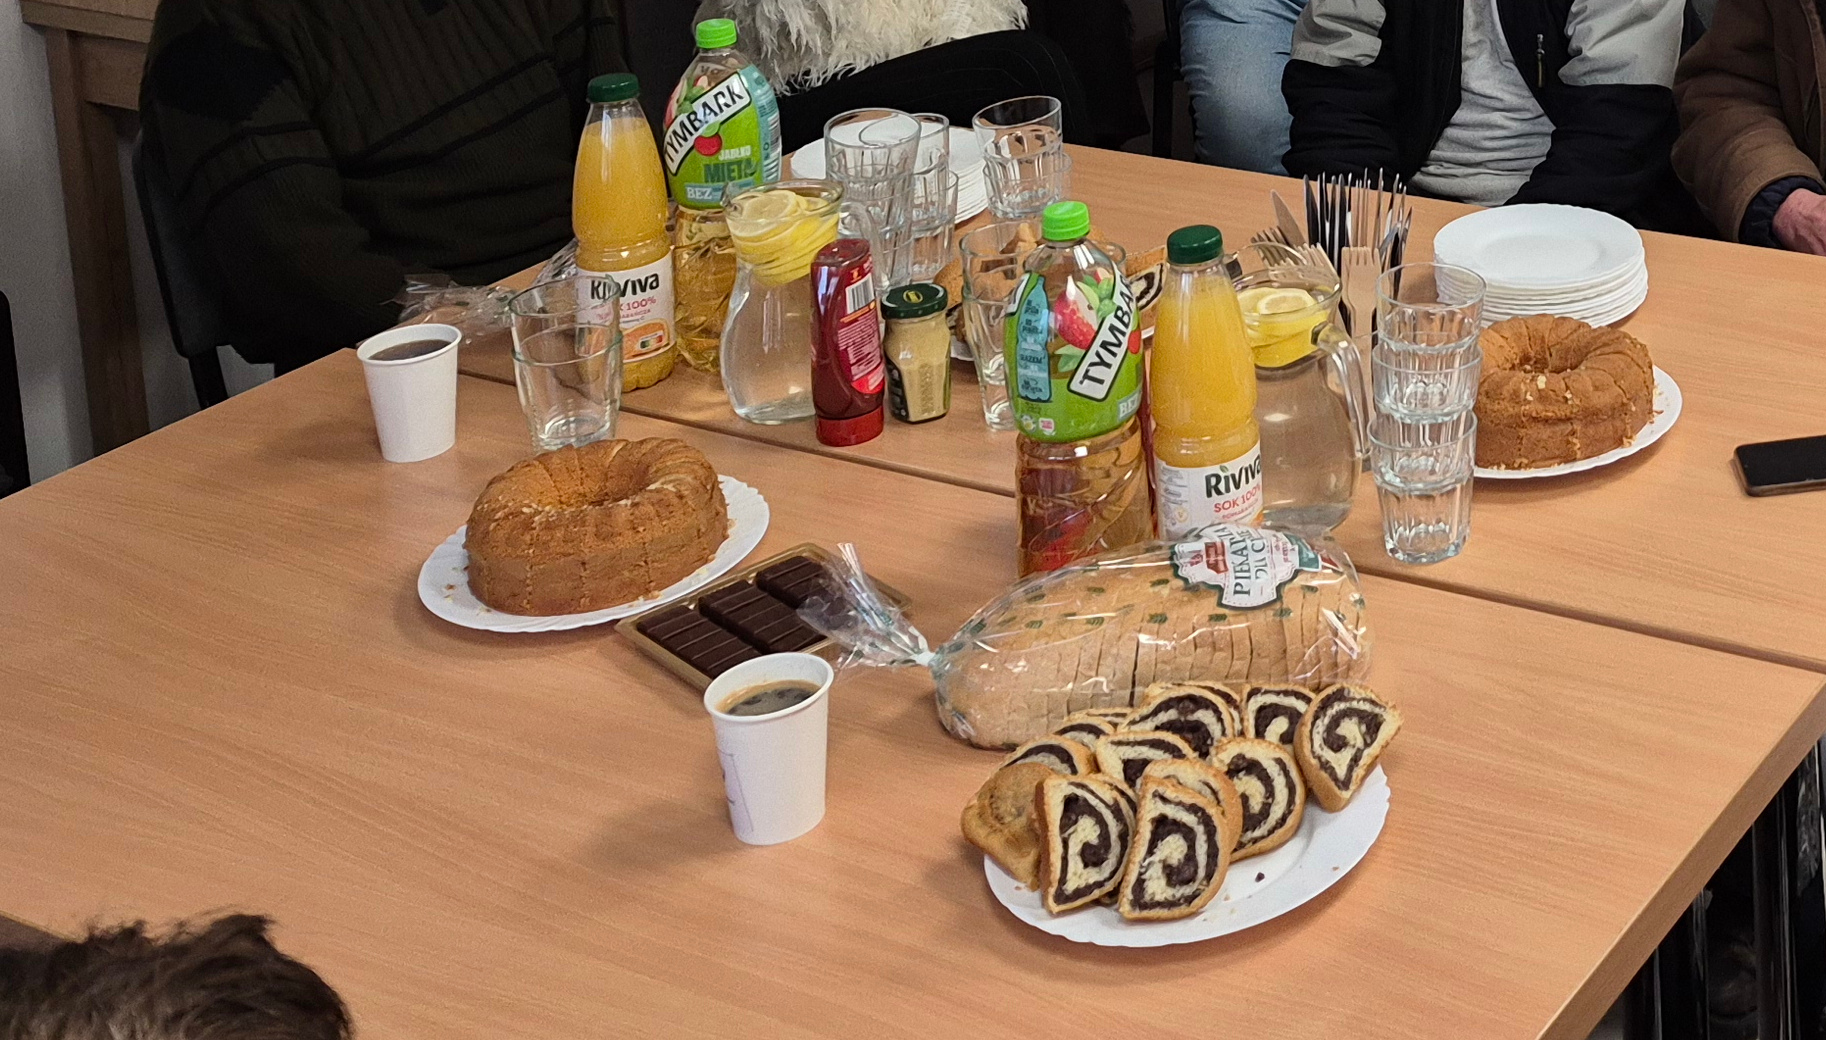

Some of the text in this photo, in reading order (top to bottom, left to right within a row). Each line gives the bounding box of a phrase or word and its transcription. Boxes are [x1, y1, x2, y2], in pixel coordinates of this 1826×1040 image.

[664, 84, 744, 163] TYMBARK
[686, 186, 713, 200] BEZ
[626, 296, 657, 311] 100%
[1214, 497, 1240, 513] SOK
